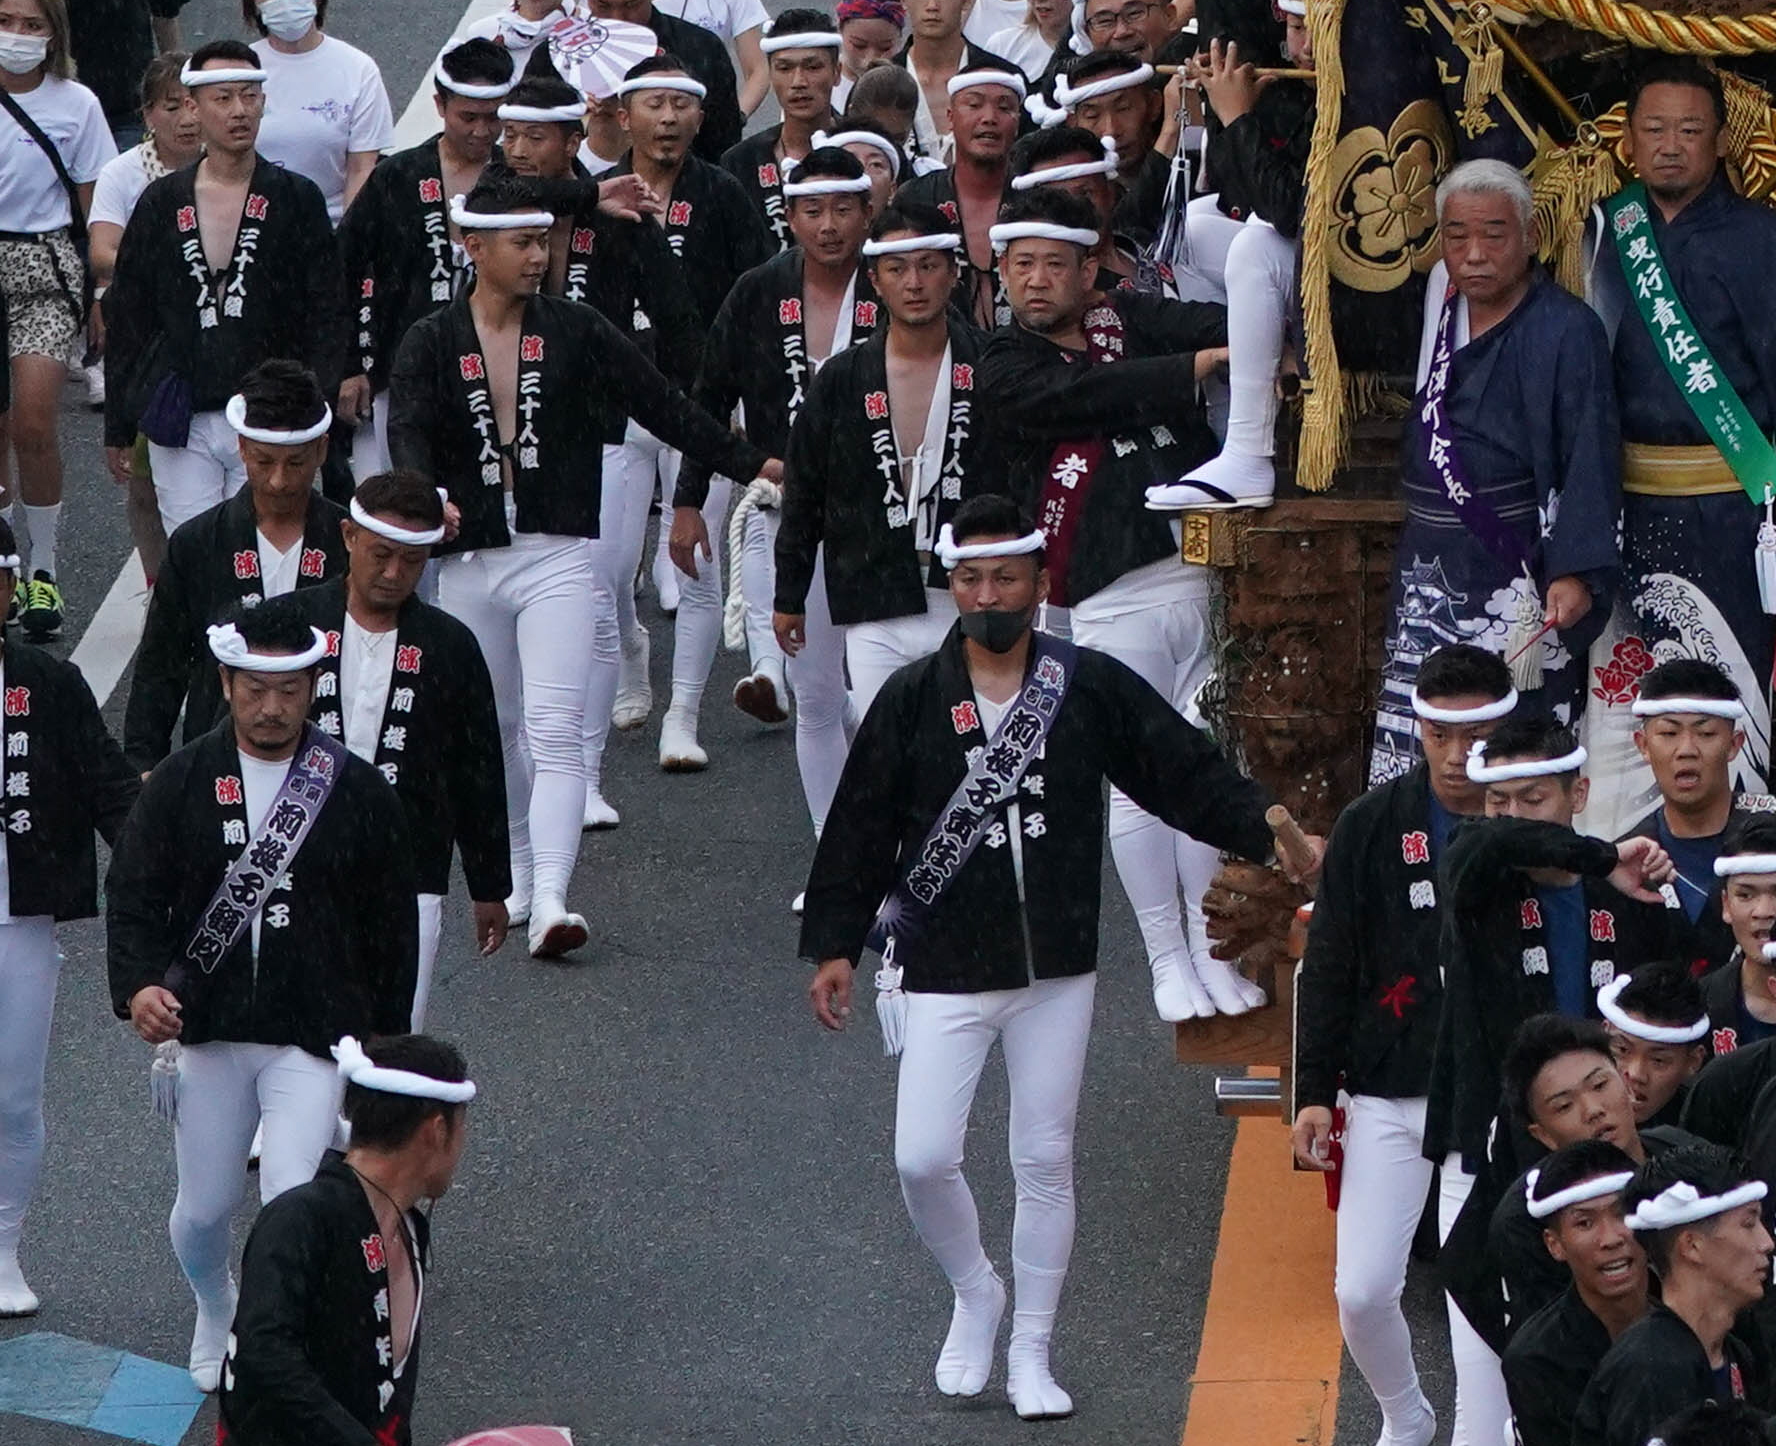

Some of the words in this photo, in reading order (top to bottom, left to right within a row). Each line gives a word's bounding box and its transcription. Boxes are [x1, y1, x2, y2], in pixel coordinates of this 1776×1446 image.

[1625, 235, 1718, 395] 曳行責任者
